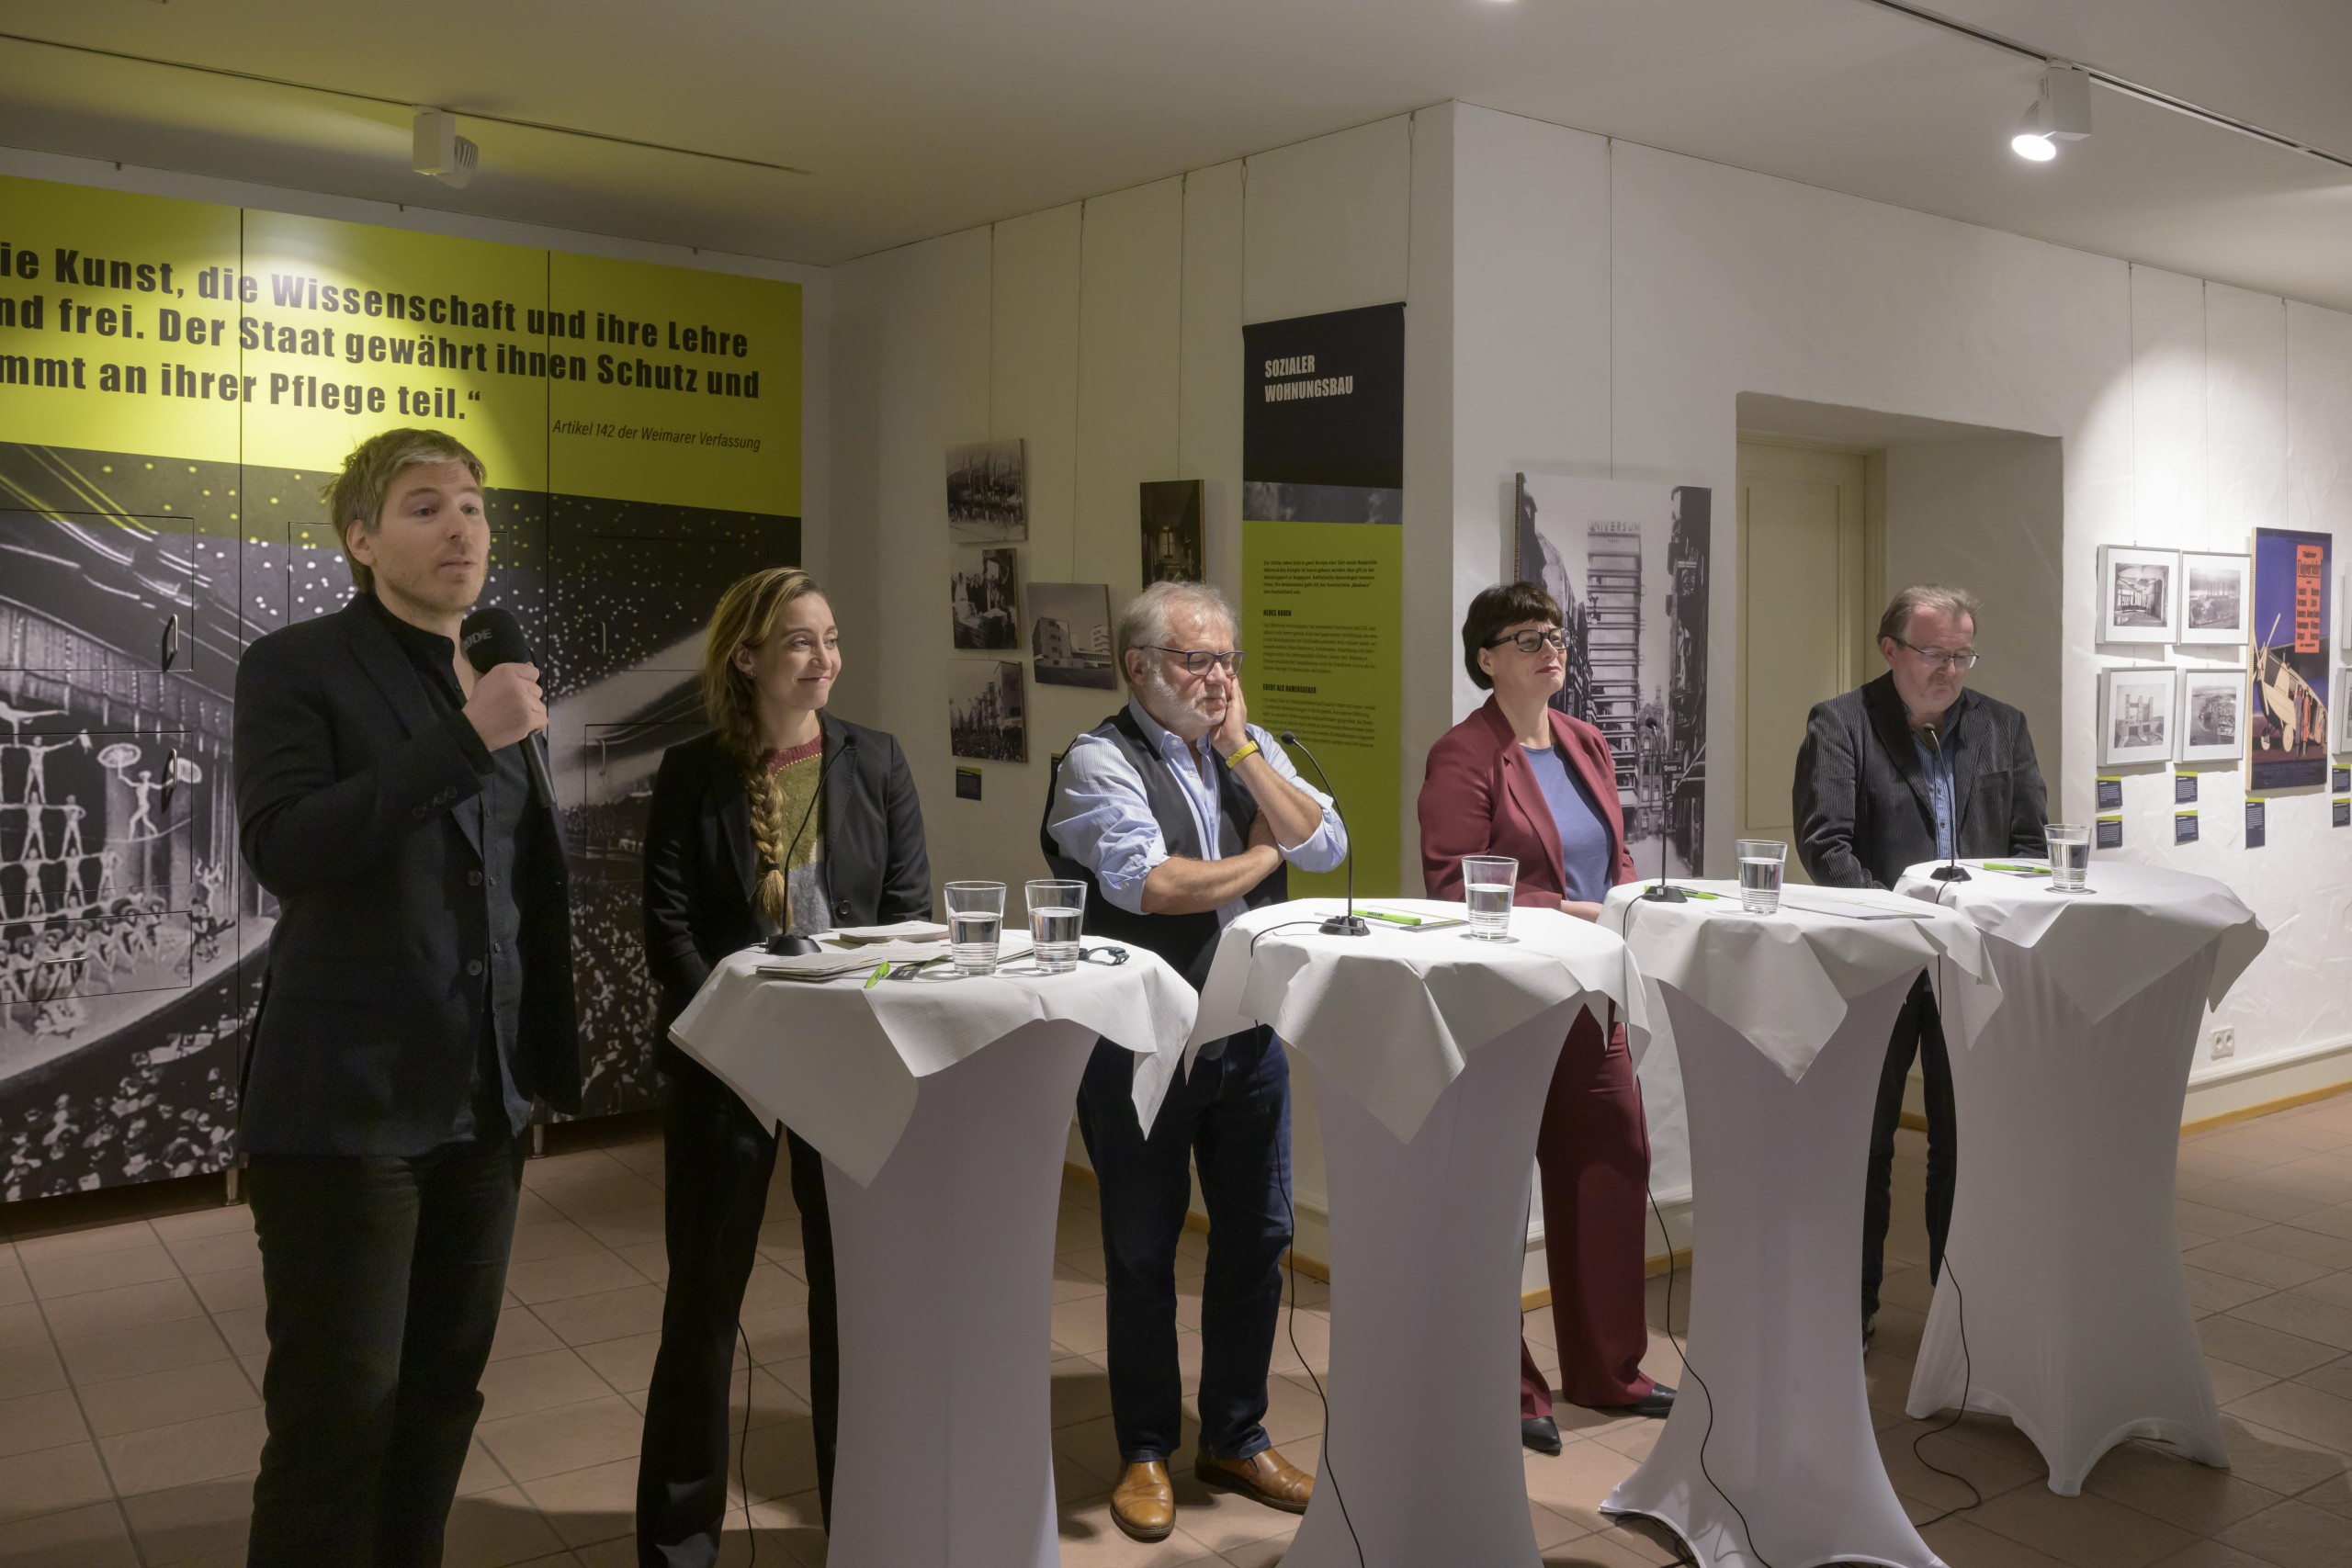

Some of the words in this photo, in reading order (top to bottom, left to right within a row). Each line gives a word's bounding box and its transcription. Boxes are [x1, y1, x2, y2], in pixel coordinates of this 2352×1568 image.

[55, 248, 184, 299] Kunst,
[198, 265, 258, 304] die
[271, 273, 515, 333] Wissenschaft
[527, 310, 585, 340] und
[597, 312, 658, 348] ihre
[668, 321, 748, 358] Lehre
[59, 298, 144, 340] frei.
[159, 308, 225, 346] Der
[239, 316, 335, 358] Staat
[345, 333, 488, 372] gewährt
[496, 344, 586, 382] ihnen
[597, 354, 698, 393] Schutz
[707, 370, 760, 400] und
[1264, 355, 1315, 378] SOZIALER
[99, 363, 147, 395] an
[161, 362, 257, 403] ihrer
[270, 372, 385, 416] Pflege
[1264, 376, 1353, 402] WOHNUNGSBAU
[552, 419, 594, 437] Artikel
[595, 423, 616, 438] 142
[617, 425, 638, 440] der
[641, 426, 697, 445] Weimarer
[699, 432, 761, 453] Verfassung
[1588, 520, 1641, 532] UNIVERSUM
